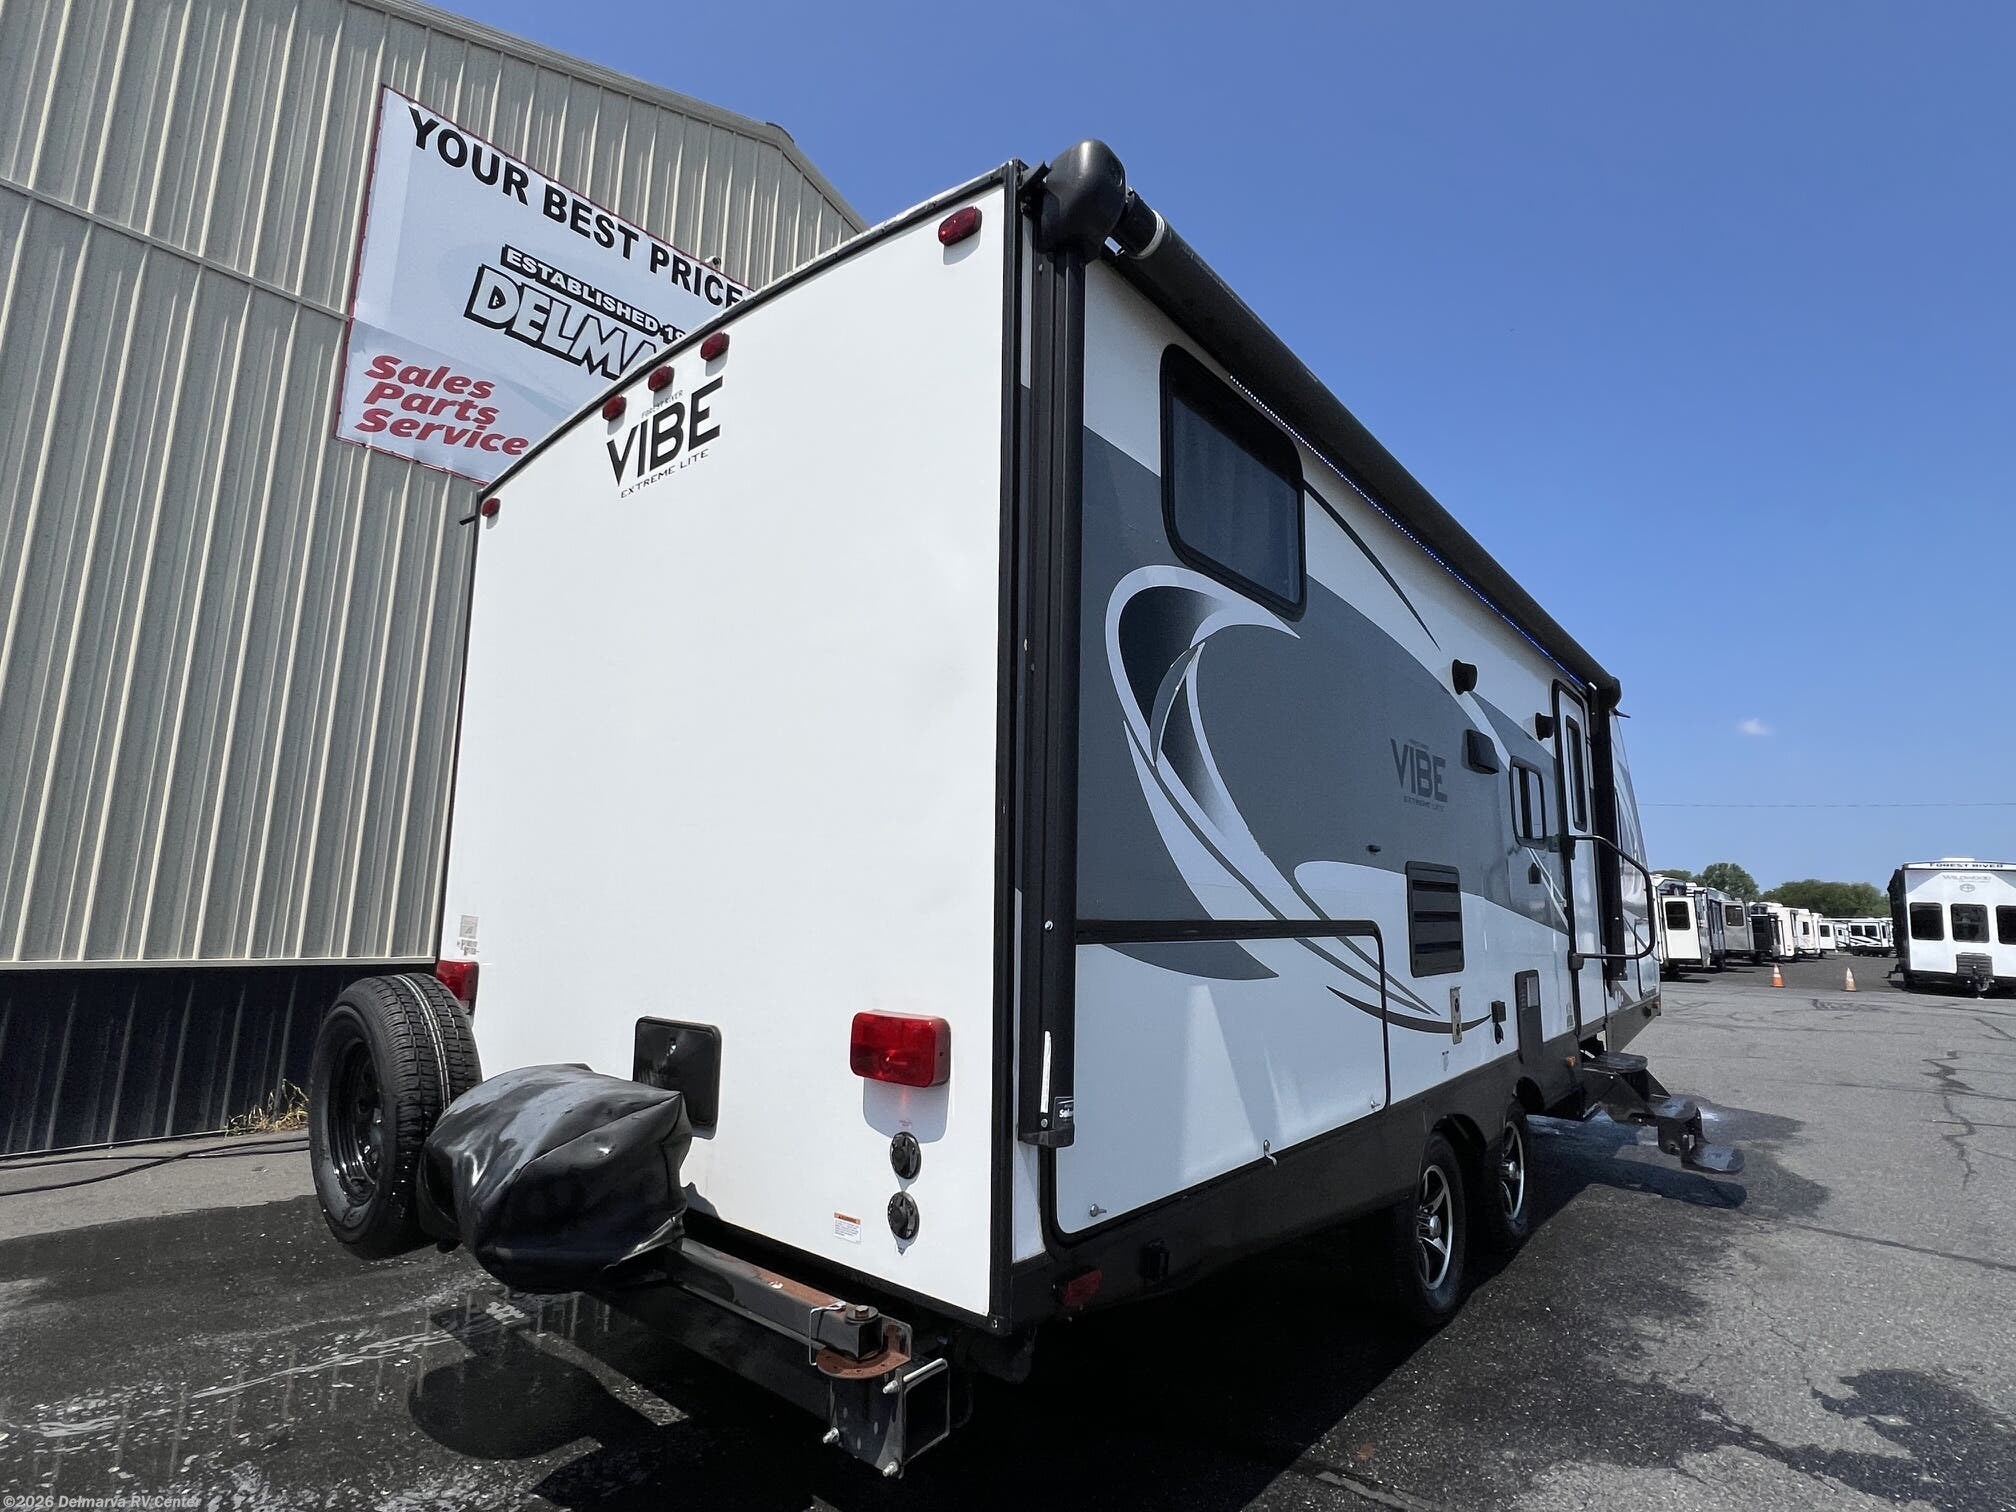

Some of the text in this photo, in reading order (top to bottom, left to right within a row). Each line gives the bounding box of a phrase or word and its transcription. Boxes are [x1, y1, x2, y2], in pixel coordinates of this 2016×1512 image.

[408, 106, 529, 206] YOUR
[543, 184, 639, 260] BEST
[502, 245, 660, 336] ESTABLISHED
[363, 355, 495, 399] Sales
[363, 381, 500, 425] Parts
[355, 408, 529, 455] Service
[607, 375, 723, 487] VIBE
[621, 449, 709, 498] EXTREME LITE
[1390, 738, 1448, 803] VIBE
